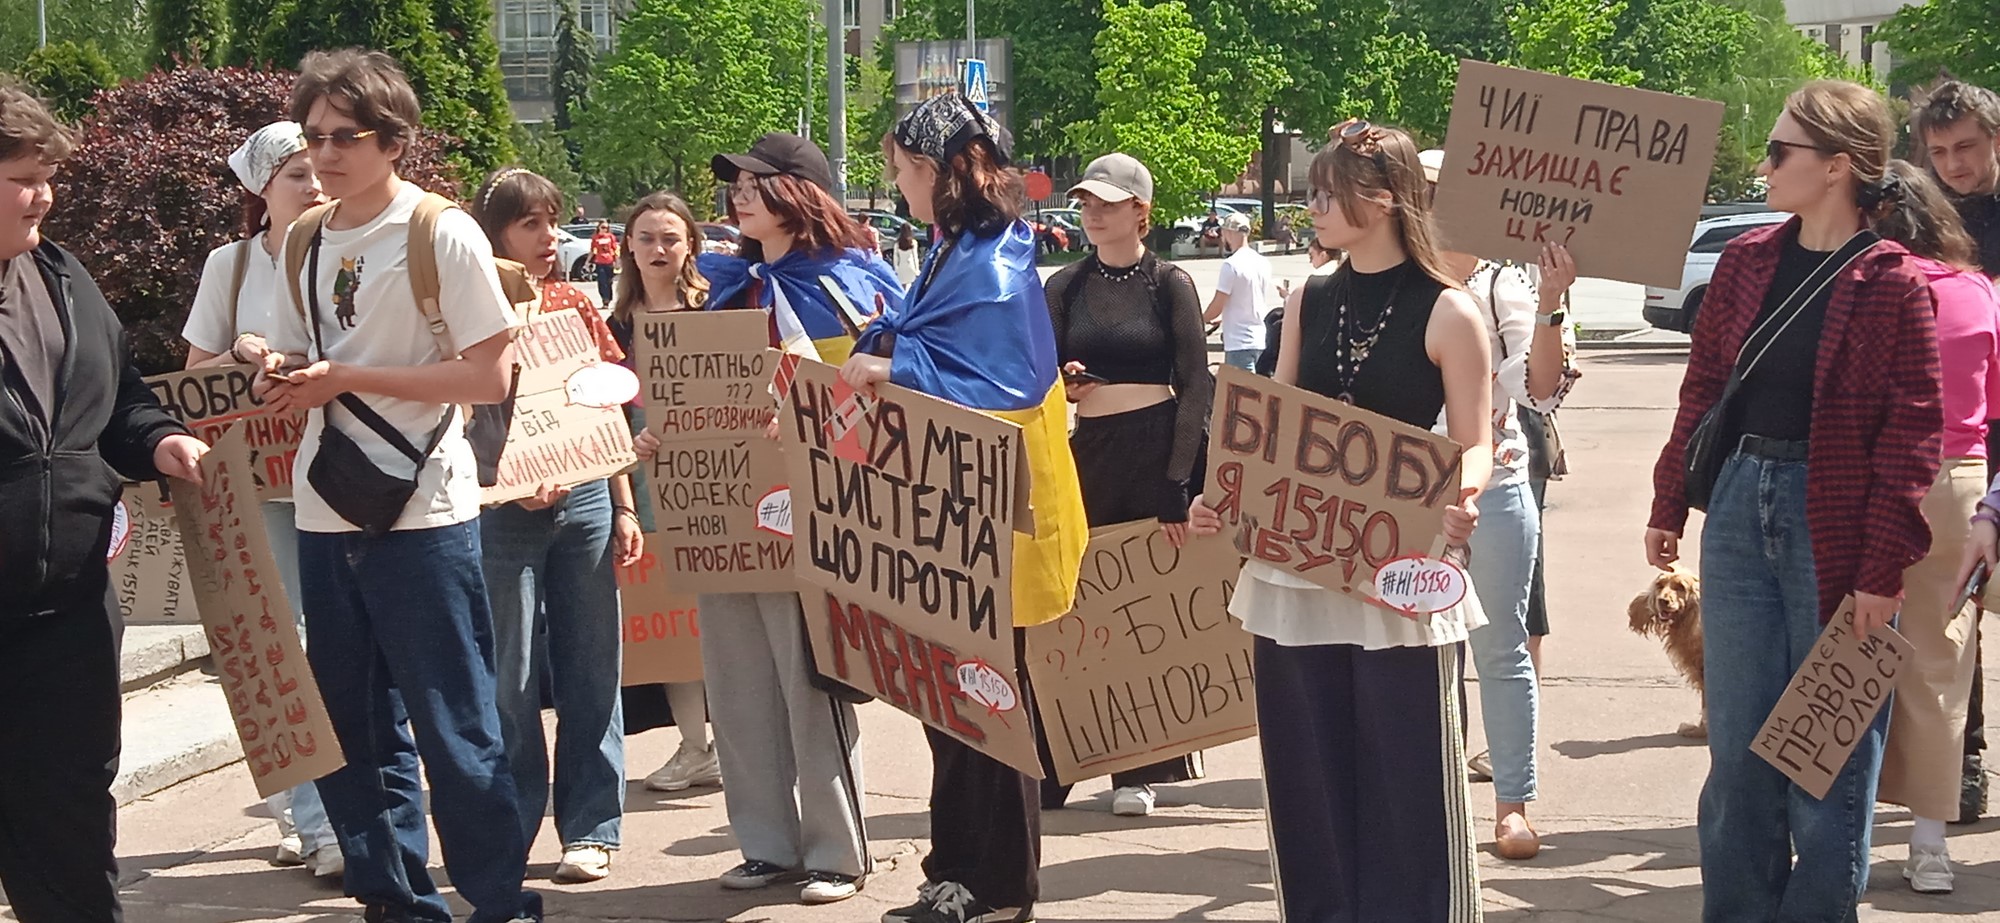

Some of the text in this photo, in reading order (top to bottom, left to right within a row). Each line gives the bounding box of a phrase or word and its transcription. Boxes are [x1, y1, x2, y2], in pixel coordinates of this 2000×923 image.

[1480, 85, 1690, 165] ЧИЇ ПРАВА
[1467, 141, 1630, 196] ЗАХИЩАЄ
[1500, 188, 1593, 224] НОВИЙ
[645, 322, 676, 350] ЧИ
[650, 353, 764, 379] ДОСТАТНЬО
[652, 382, 686, 406] ЦЕ
[521, 410, 560, 437] ВІД
[789, 378, 914, 483] НАУЯ
[1221, 383, 1463, 508] БІ БО БУ
[654, 441, 750, 480] НОВИЙ
[658, 482, 754, 511] КОДЕКС
[808, 447, 999, 578] СИСТЕМА
[1213, 461, 1400, 569] Я 15150
[674, 541, 795, 572] ПРОБЛЕМИ
[871, 541, 998, 641] ПРОТИ
[826, 594, 986, 743] МЕНЕ
[1776, 634, 1884, 772] ПРАВО НА
[1761, 716, 1790, 750] МИ
